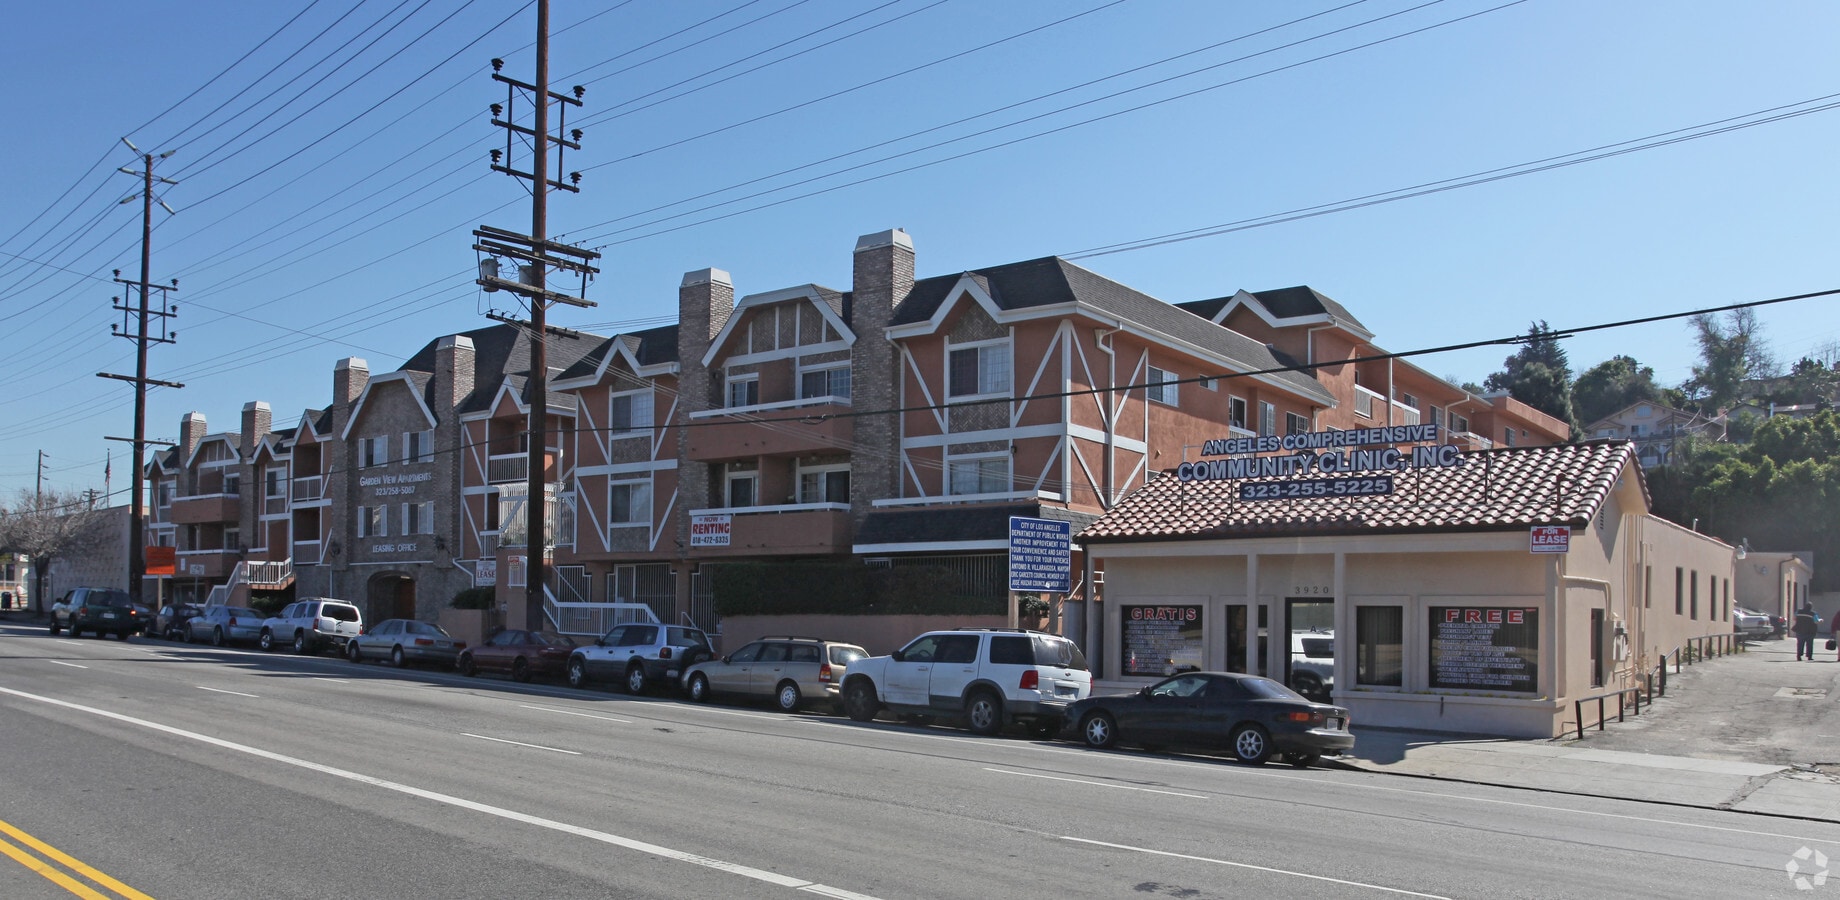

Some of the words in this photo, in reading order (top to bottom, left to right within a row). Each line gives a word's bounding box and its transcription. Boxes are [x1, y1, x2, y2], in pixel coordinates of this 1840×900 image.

[1201, 436, 1281, 456] ANGELES
[1282, 424, 1438, 450] COMPREHENSIVE
[1178, 455, 1314, 481] COMMUNITY
[1318, 448, 1407, 473] CLINIC,
[1411, 445, 1465, 467] INC.
[1244, 479, 1388, 498] 323-255-5225
[693, 523, 730, 534] RENTING
[1044, 524, 1061, 532] ANGELES
[1011, 529, 1036, 537] DEPARTMENT
[1032, 539, 1058, 547] IMPROVEMENT
[1532, 535, 1567, 544] LEASE
[373, 544, 395, 553] LEASING
[397, 543, 417, 552] OFFICE
[1022, 547, 1047, 555] CONVENIENCE
[477, 570, 496, 578] LEASE
[1295, 586, 1329, 594] 3920
[1131, 607, 1197, 620] GRATIS
[1446, 608, 1524, 624] FREE
